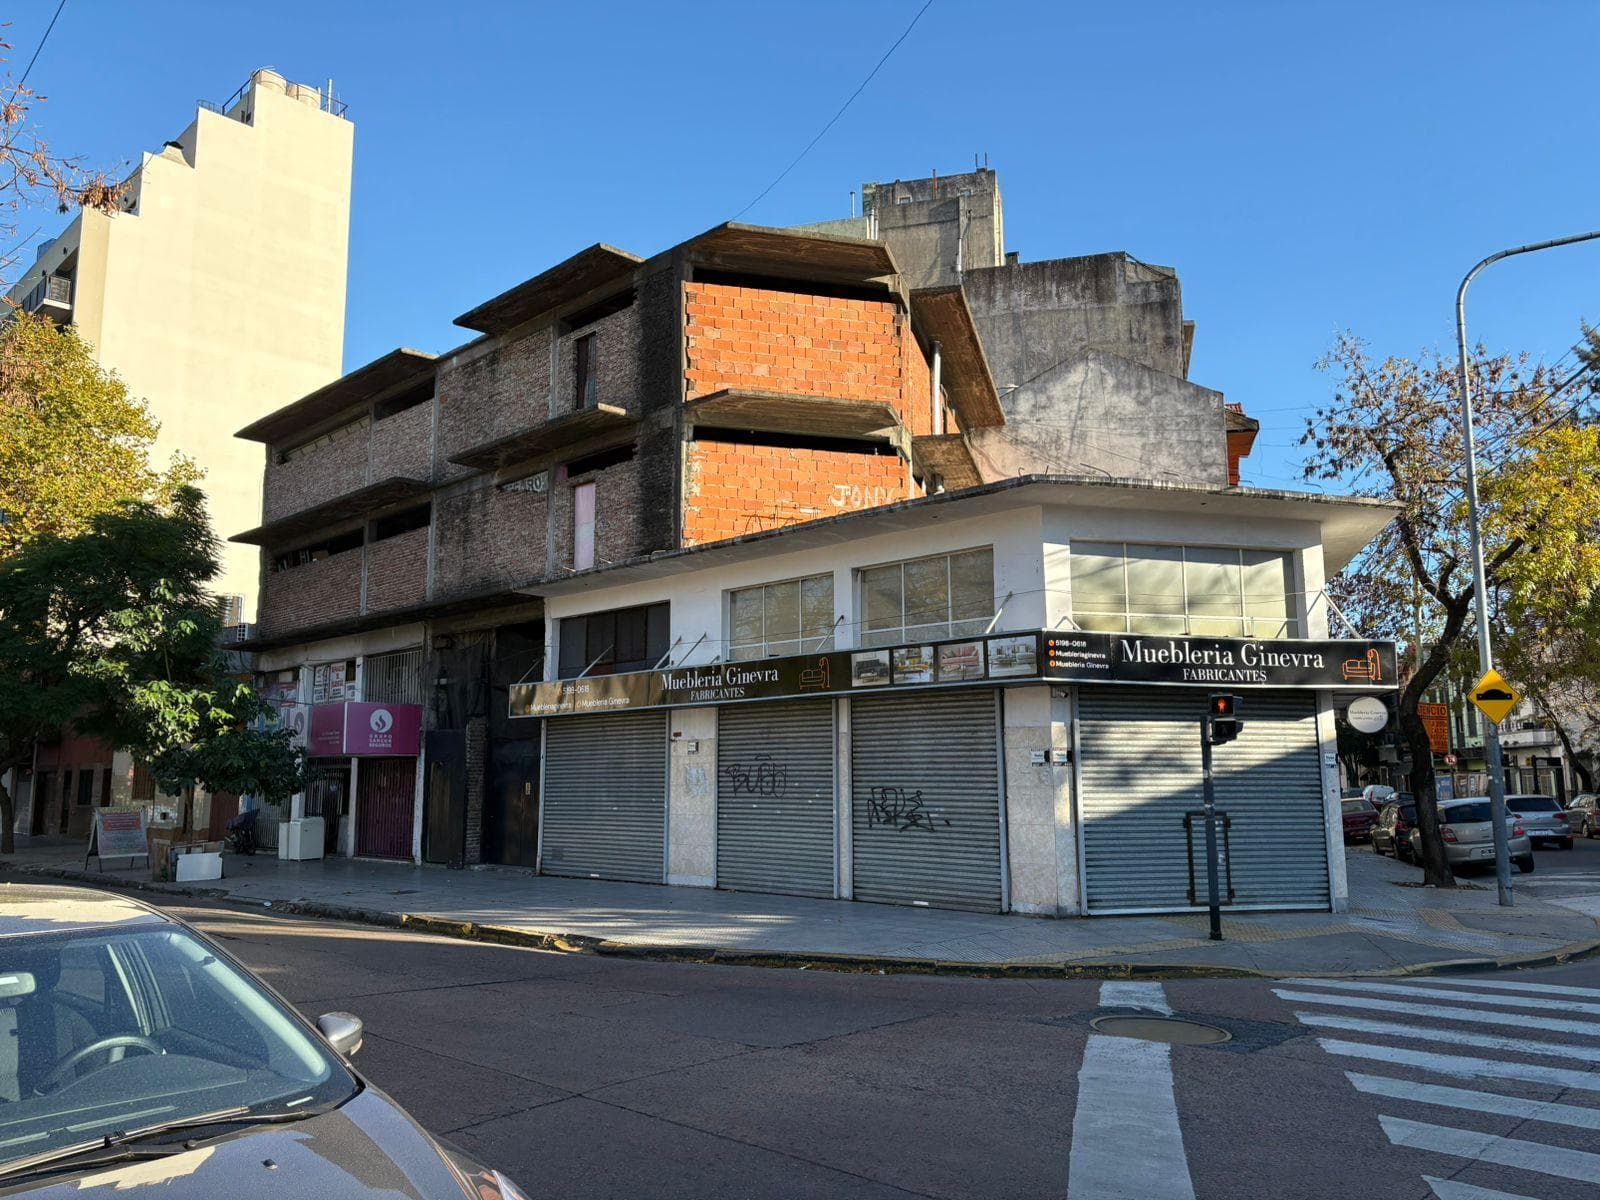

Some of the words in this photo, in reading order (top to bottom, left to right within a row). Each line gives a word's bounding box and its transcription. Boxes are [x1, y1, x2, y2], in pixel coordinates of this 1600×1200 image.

[1121, 639, 1235, 666] Muebleria
[1241, 643, 1325, 669] Ginevra
[662, 670, 722, 691] Muebleria
[726, 666, 779, 686] Ginevra
[1183, 668, 1267, 682] FABRICANTES
[690, 687, 745, 701] FABRICANTES
[582, 698, 608, 708] Muebleria
[608, 697, 630, 706] Ginevra
